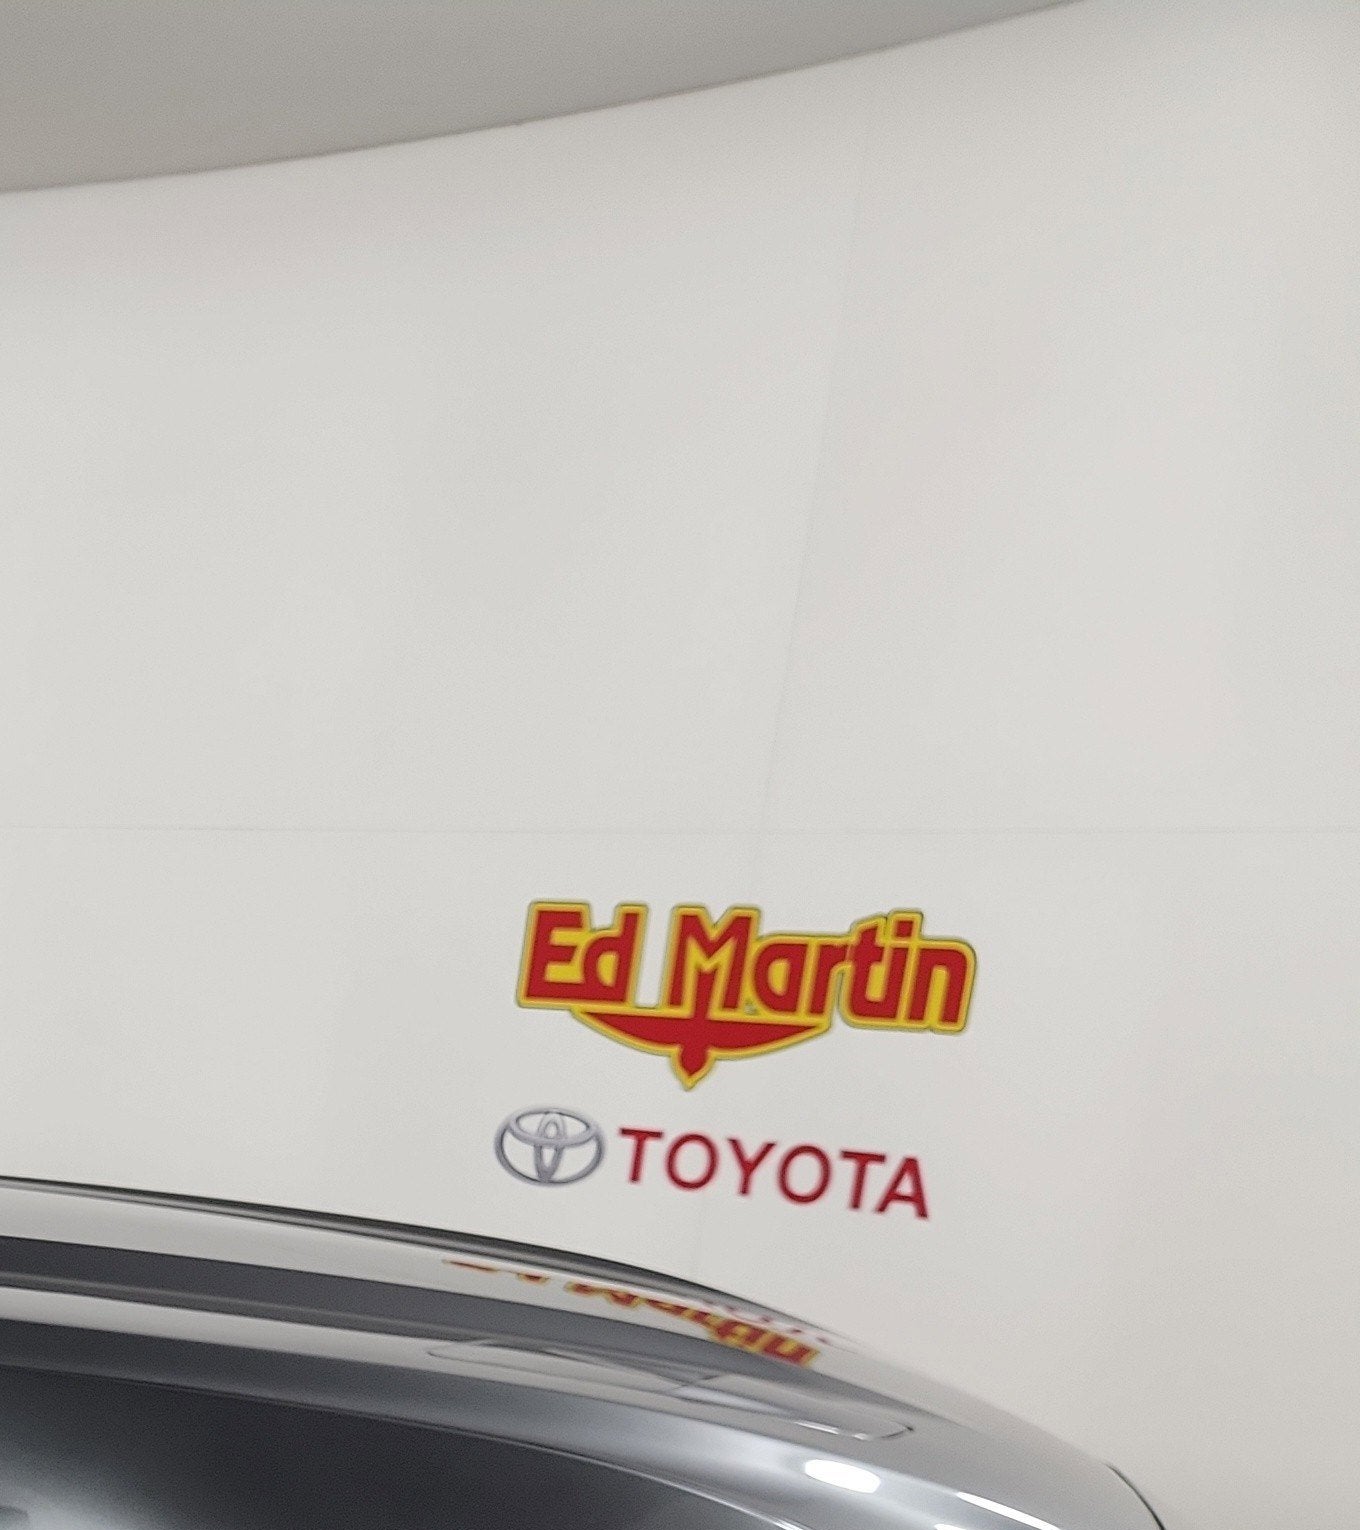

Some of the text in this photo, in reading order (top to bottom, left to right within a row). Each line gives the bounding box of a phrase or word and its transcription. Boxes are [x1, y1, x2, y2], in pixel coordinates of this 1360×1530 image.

[516, 901, 976, 1034] Ed Martin
[620, 1126, 930, 1220] TOYOTA
